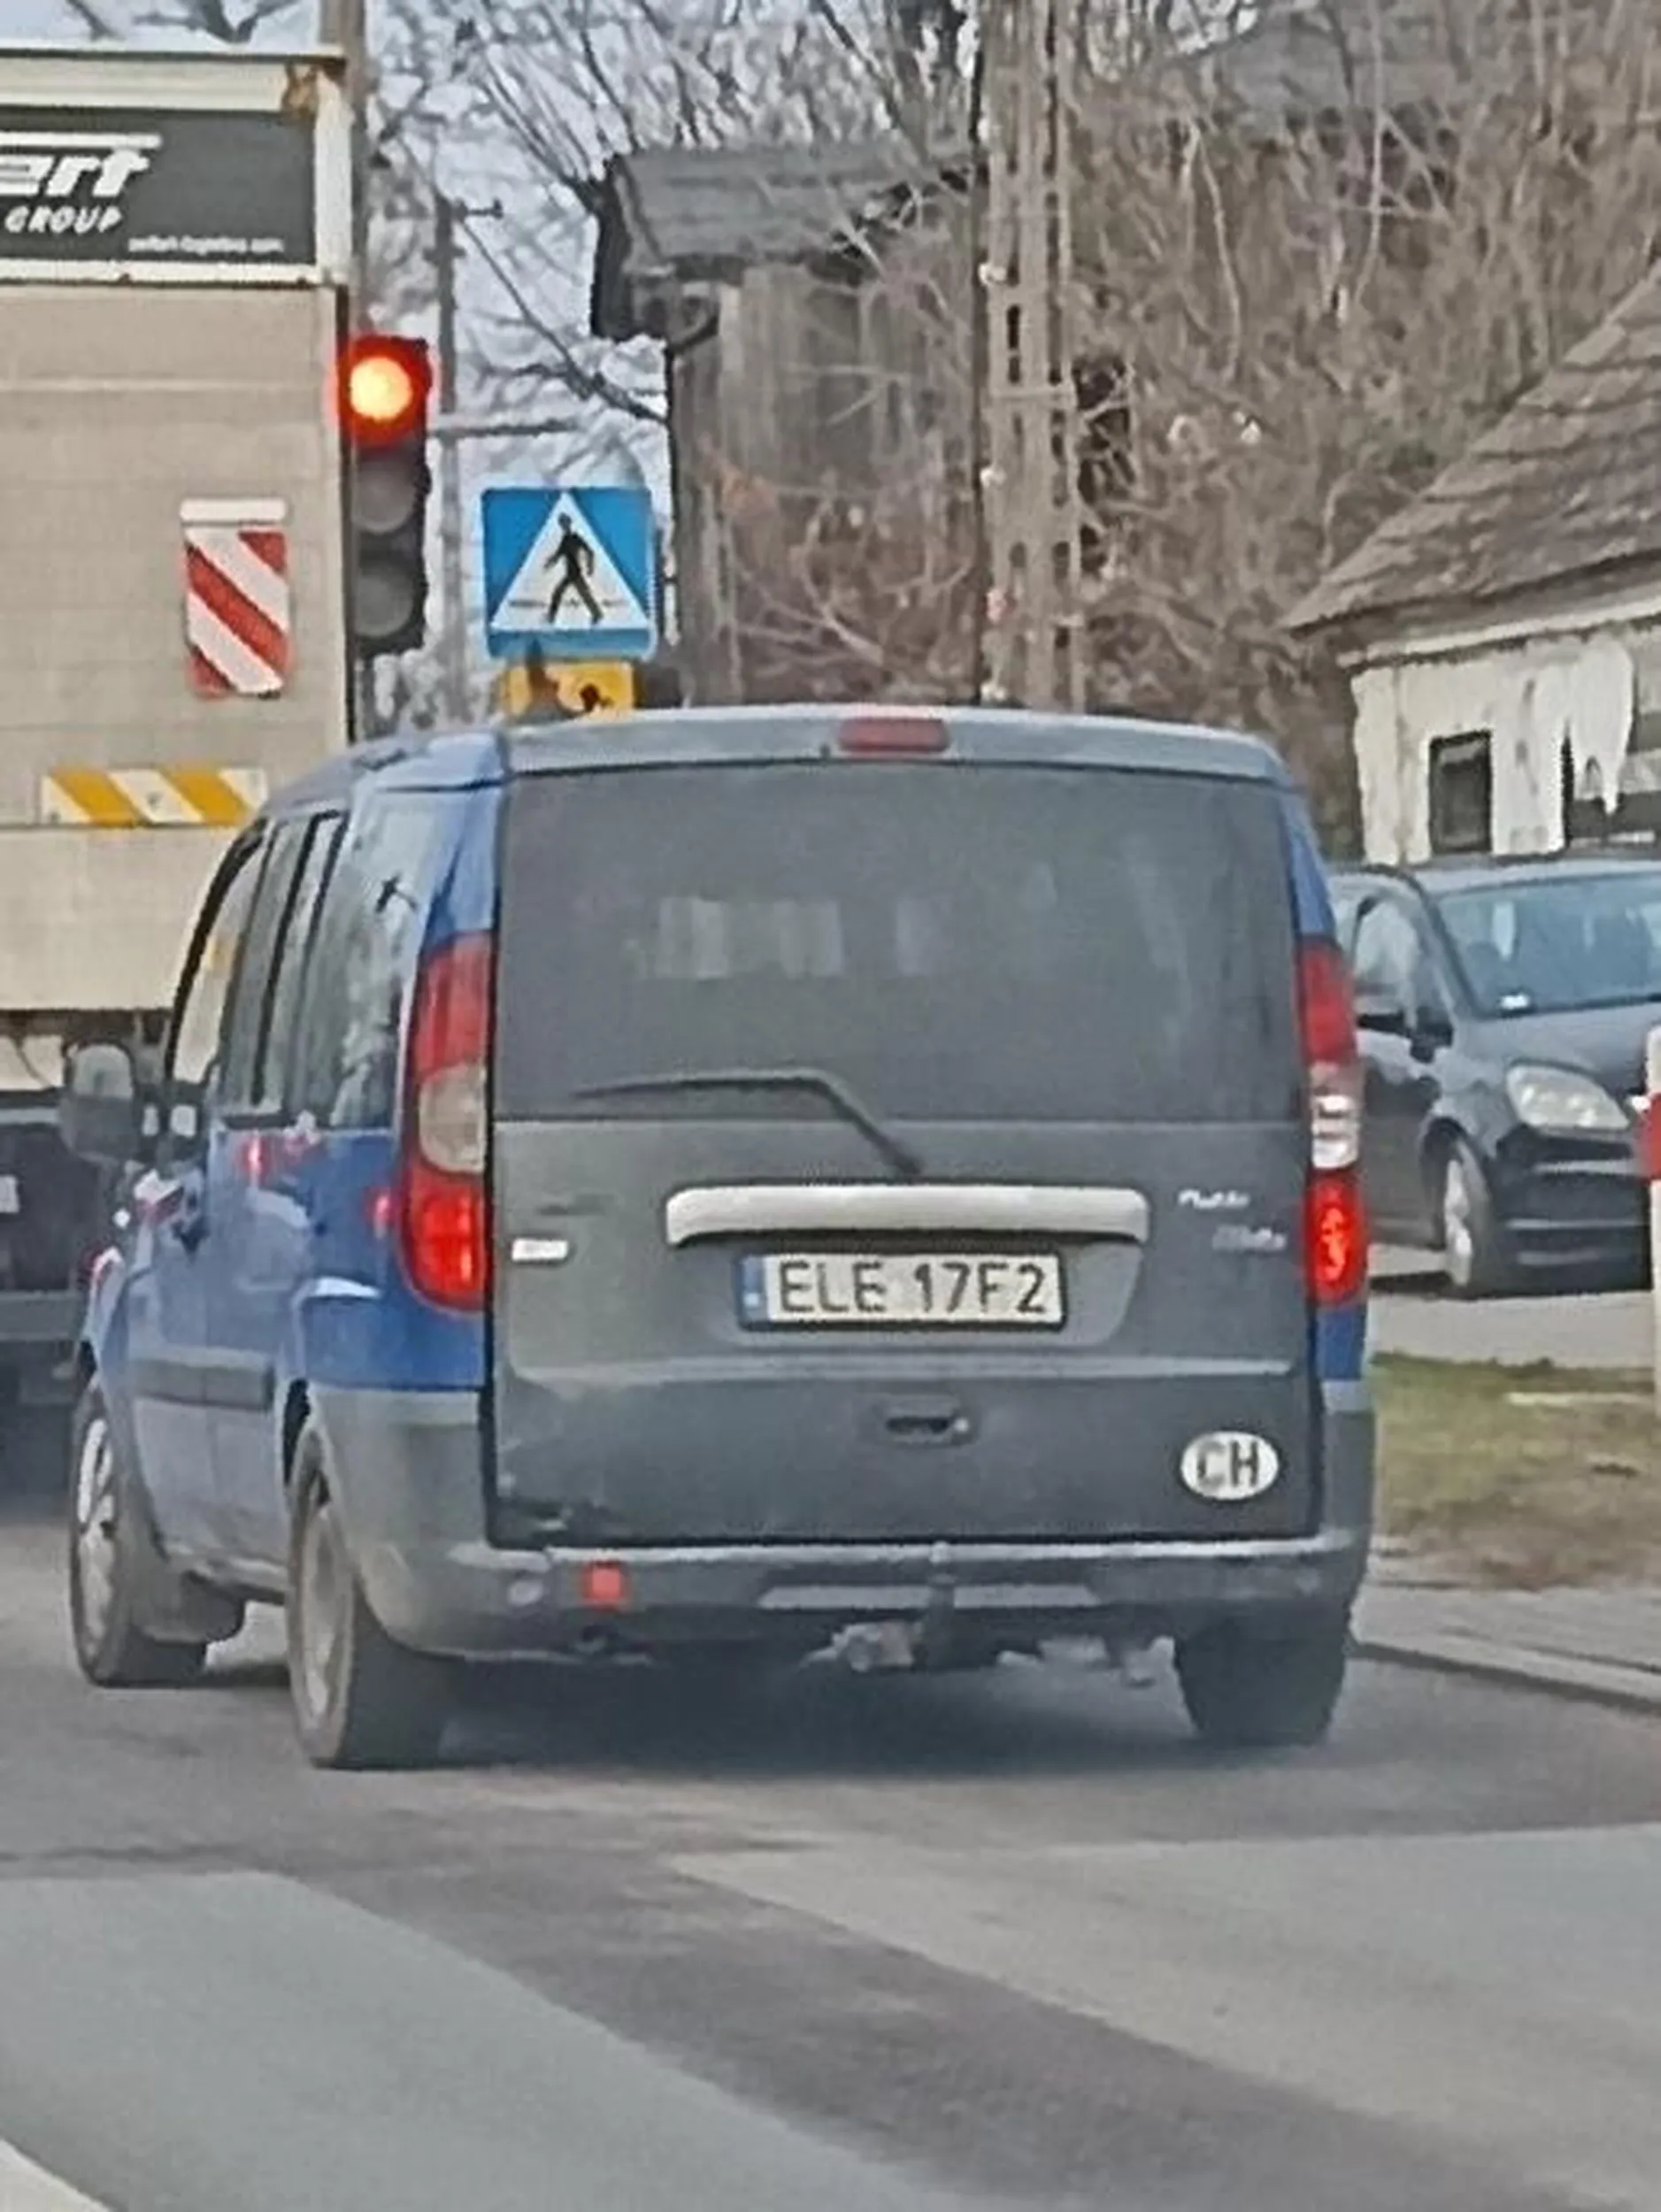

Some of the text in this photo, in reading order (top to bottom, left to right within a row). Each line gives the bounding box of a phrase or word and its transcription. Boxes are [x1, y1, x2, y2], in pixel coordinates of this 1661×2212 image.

[4, 205, 122, 234] GROUP
[780, 1260, 1045, 1315] ELE 17F2
[1196, 1440, 1258, 1490] CH
